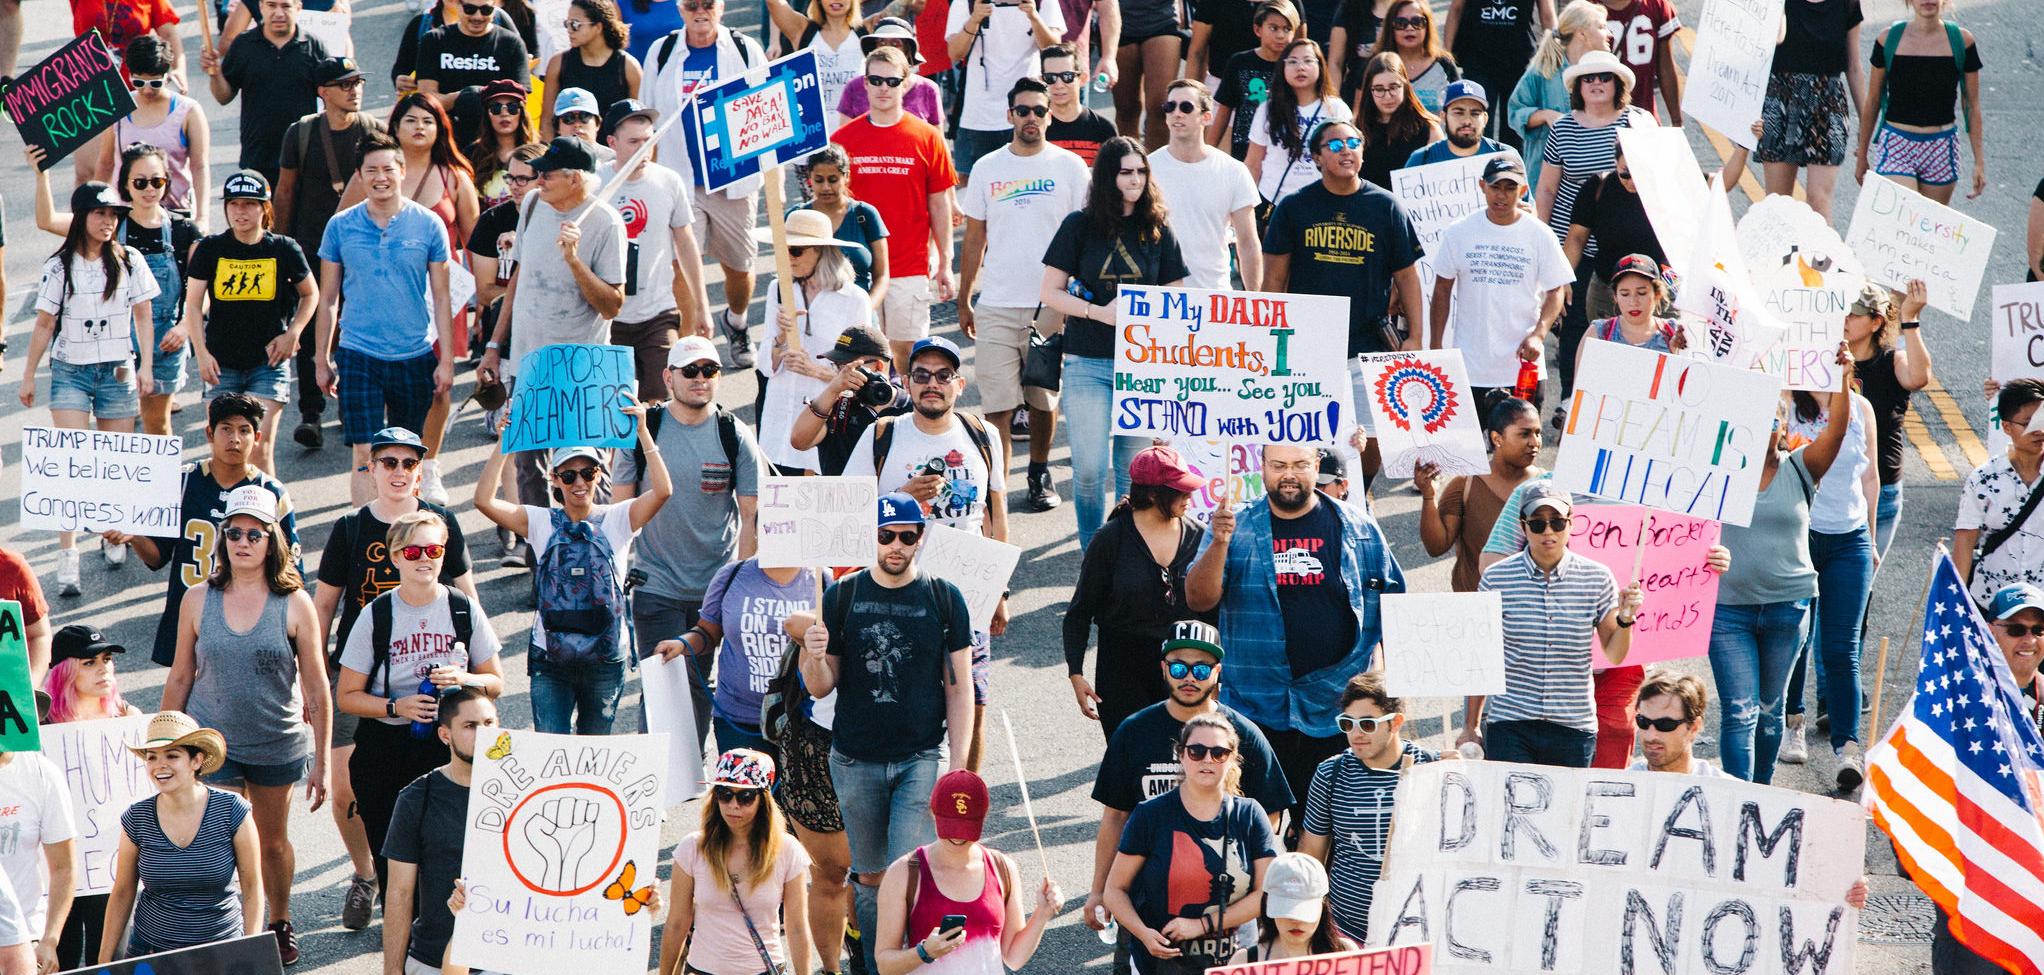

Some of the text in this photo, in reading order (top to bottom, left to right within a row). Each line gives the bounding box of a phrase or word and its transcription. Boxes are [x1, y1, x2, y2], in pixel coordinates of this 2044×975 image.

[1481, 6, 1518, 20] EMC
[440, 53, 500, 71] Resist.
[5, 33, 112, 124] IMMIGRANTS
[42, 80, 117, 147] ROCK!
[732, 92, 762, 112] SAVE
[746, 92, 783, 124] DACA!
[739, 118, 789, 150] NO WALL
[740, 111, 784, 137] NO BAN
[851, 155, 915, 165] IMMIGRANTS MAKE
[887, 167, 910, 175] GREAT
[1871, 181, 1969, 256] Diversity
[1305, 226, 1375, 252] RIVERSIDE
[1865, 228, 1958, 281] America
[1896, 228, 1936, 255] makes
[1121, 289, 1289, 332] To My DACA
[1765, 289, 1845, 314] ACTION
[1124, 324, 1269, 376] Students,
[526, 346, 627, 387] SUPPORT
[1649, 353, 1711, 407] NO
[1116, 372, 1166, 393] Hear
[1238, 379, 1276, 400] See
[508, 384, 633, 450] DREAMERS
[1118, 397, 1207, 437] STAND
[1567, 389, 1753, 471] DREAM IS
[24, 428, 179, 456] TRUMP FAILED US
[25, 456, 151, 482] We believe
[23, 491, 124, 531] Congress
[765, 484, 789, 508] I
[795, 483, 875, 513] STAND
[882, 499, 896, 517] LA
[763, 516, 875, 560] WITH DACA
[743, 597, 809, 616] I STAND
[740, 613, 767, 634] ON
[475, 747, 660, 833] DREAMERS
[1439, 771, 1806, 888] DREAM
[525, 896, 599, 921] lucha
[1387, 873, 1845, 975] ACT NOW
[482, 922, 634, 951] es mi lucha!
